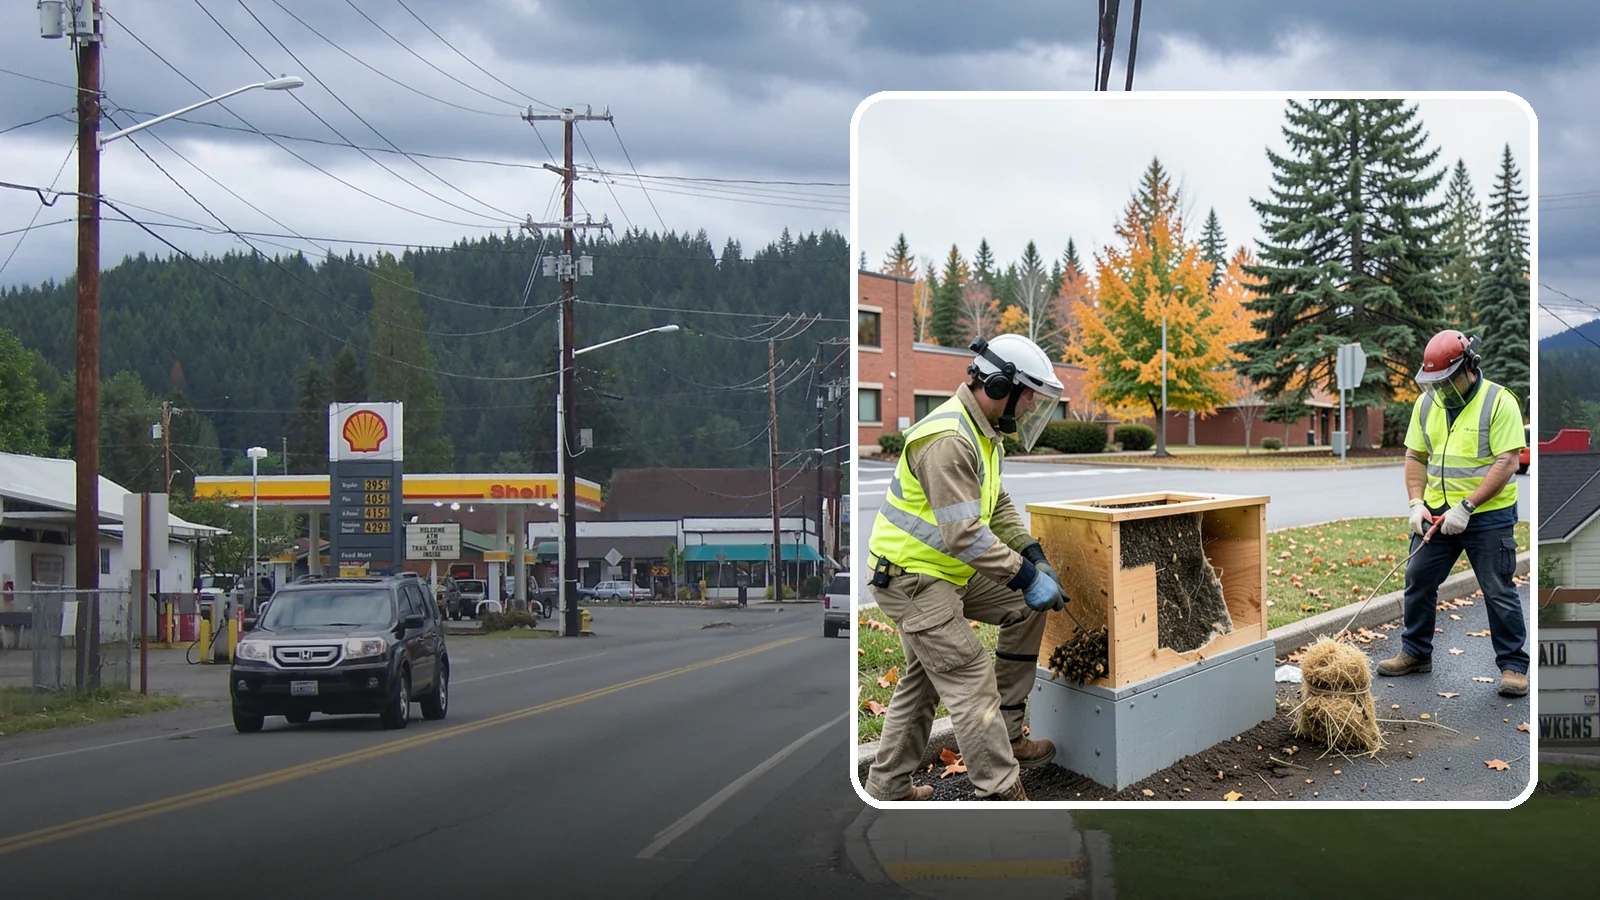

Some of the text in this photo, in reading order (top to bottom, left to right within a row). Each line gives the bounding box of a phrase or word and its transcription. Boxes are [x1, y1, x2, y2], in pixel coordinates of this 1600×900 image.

[366, 480, 383, 490] 395
[490, 484, 547, 499] Shell
[365, 494, 383, 504] 405
[365, 508, 383, 518] 415
[366, 522, 383, 532] 429
[1538, 643, 1567, 665] AID
